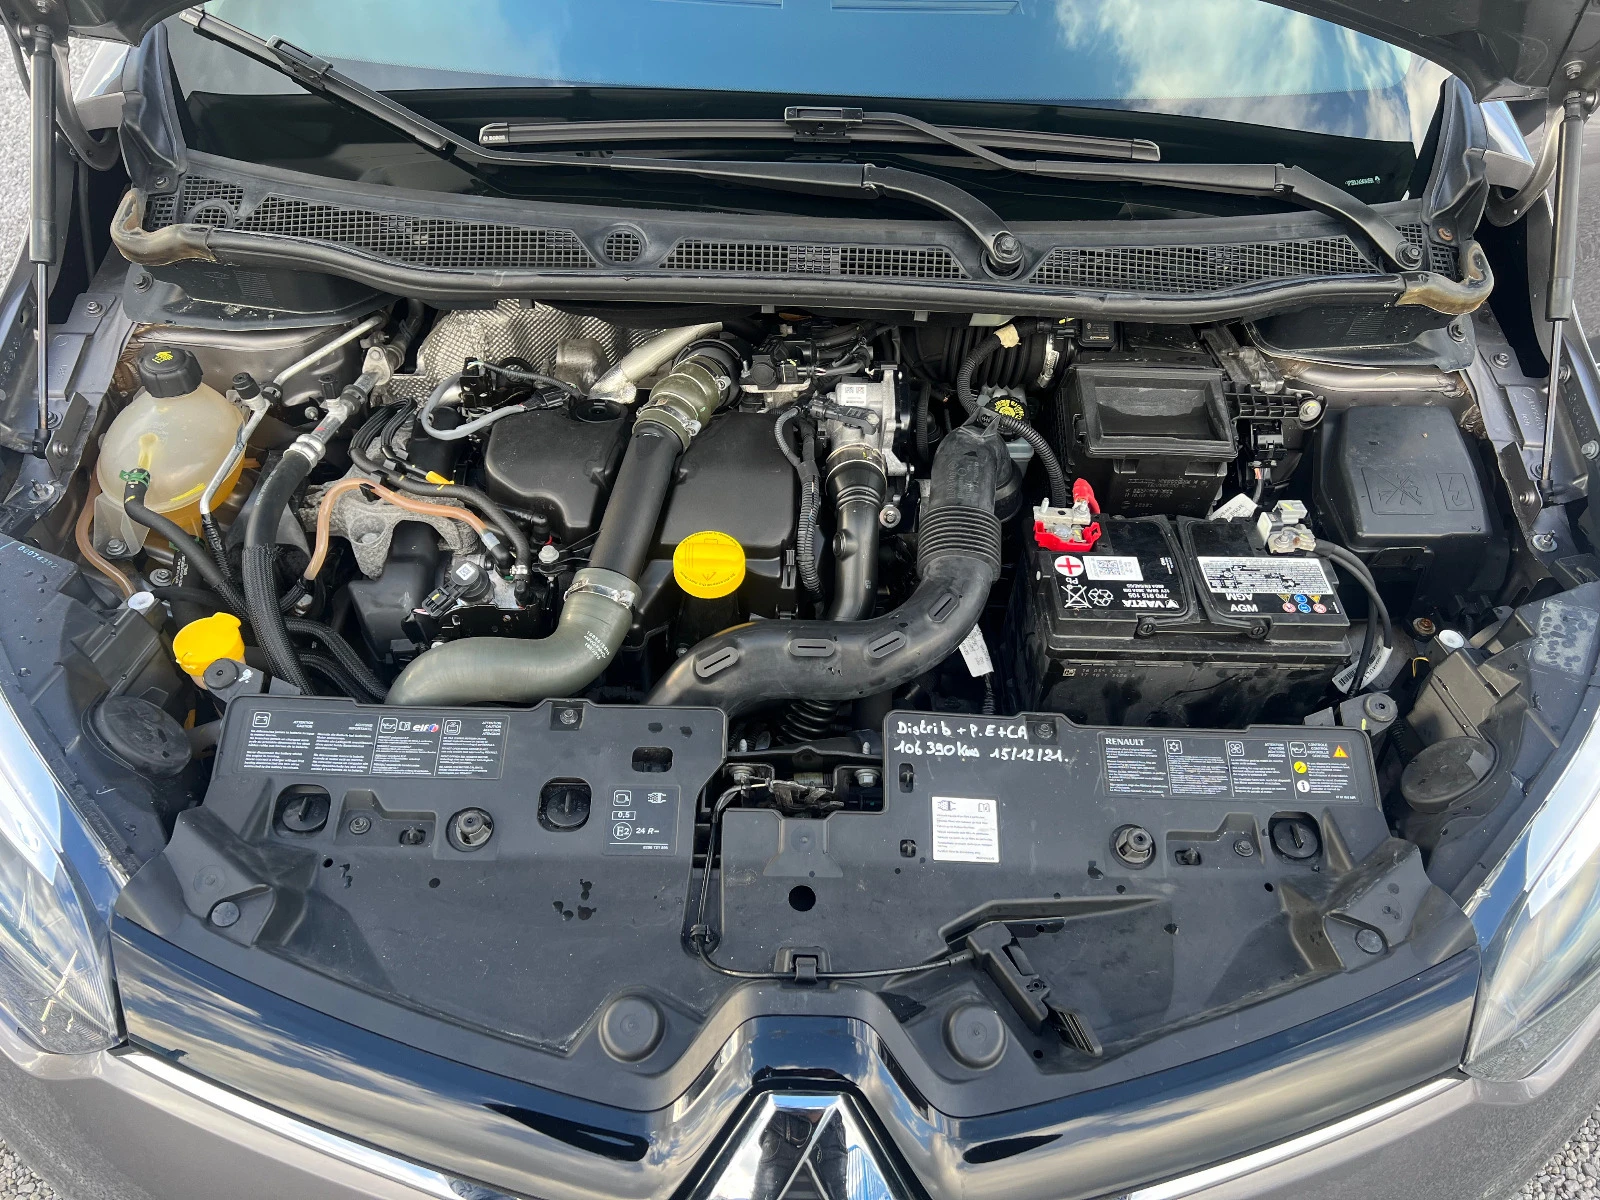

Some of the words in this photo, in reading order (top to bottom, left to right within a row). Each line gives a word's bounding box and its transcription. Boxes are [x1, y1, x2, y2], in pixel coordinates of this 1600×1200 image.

[1121, 599, 1165, 608] VARTA
[1230, 603, 1259, 613] AGM
[412, 724, 430, 732] elf
[1105, 737, 1145, 746] RENAULT
[635, 827, 646, 835] 24
